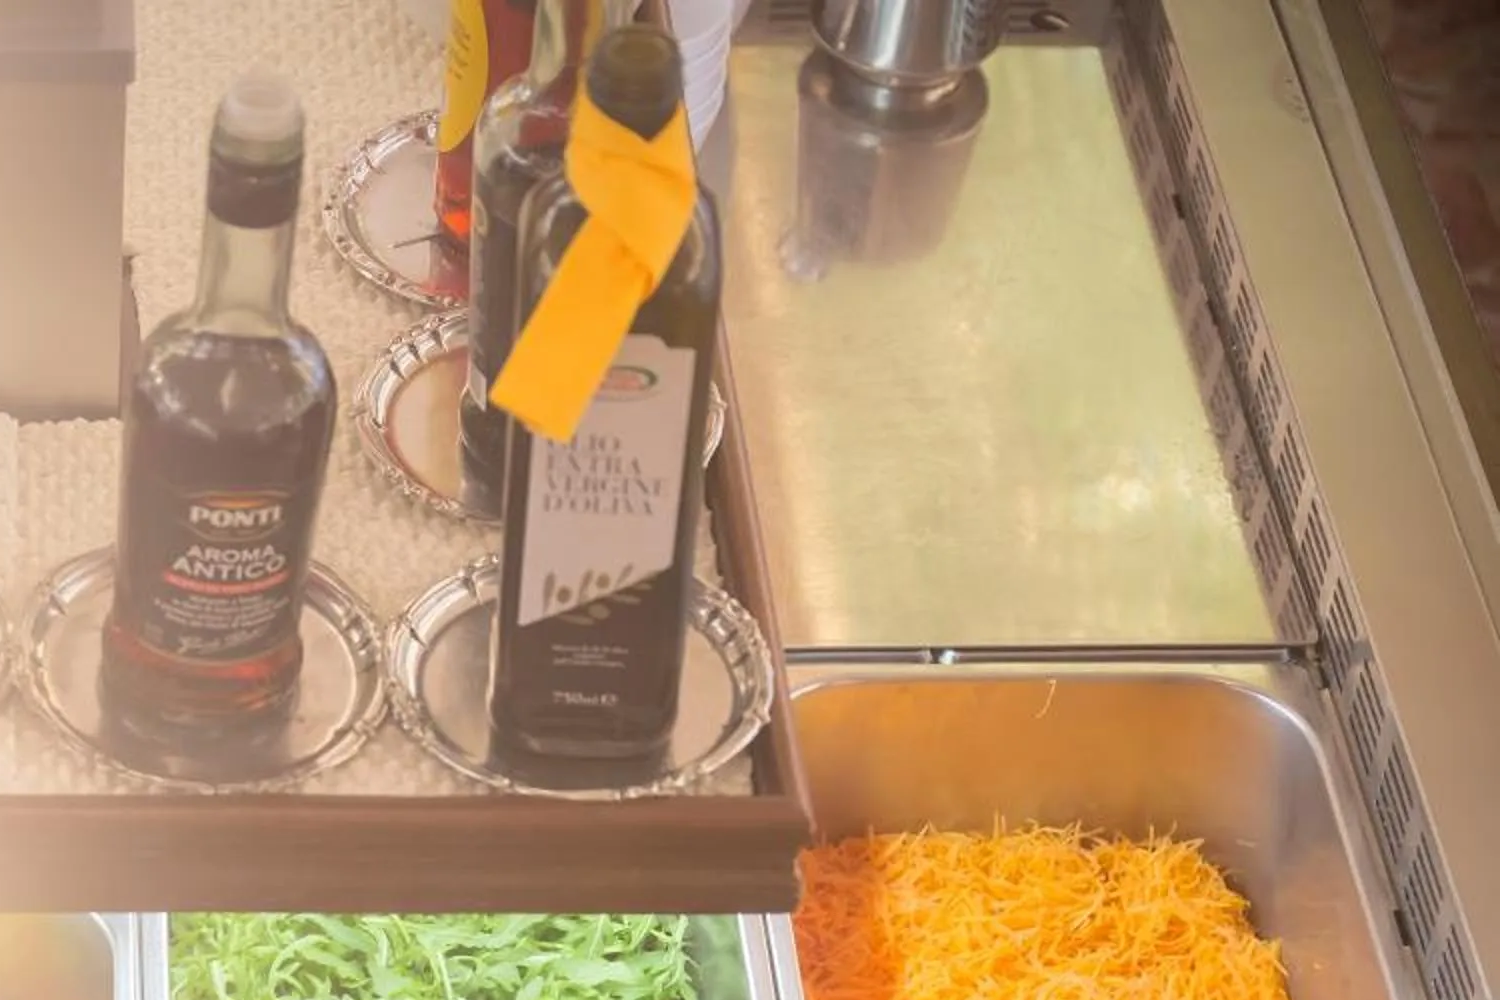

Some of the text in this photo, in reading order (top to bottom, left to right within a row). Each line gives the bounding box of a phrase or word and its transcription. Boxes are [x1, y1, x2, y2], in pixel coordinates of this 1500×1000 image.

[546, 453, 642, 475] EXTRA
[546, 474, 669, 497] VERGINE
[188, 504, 283, 528] PONTI
[542, 493, 654, 516] D'OLIVA
[185, 544, 277, 563] AROMA
[172, 553, 287, 581] ANTICO
